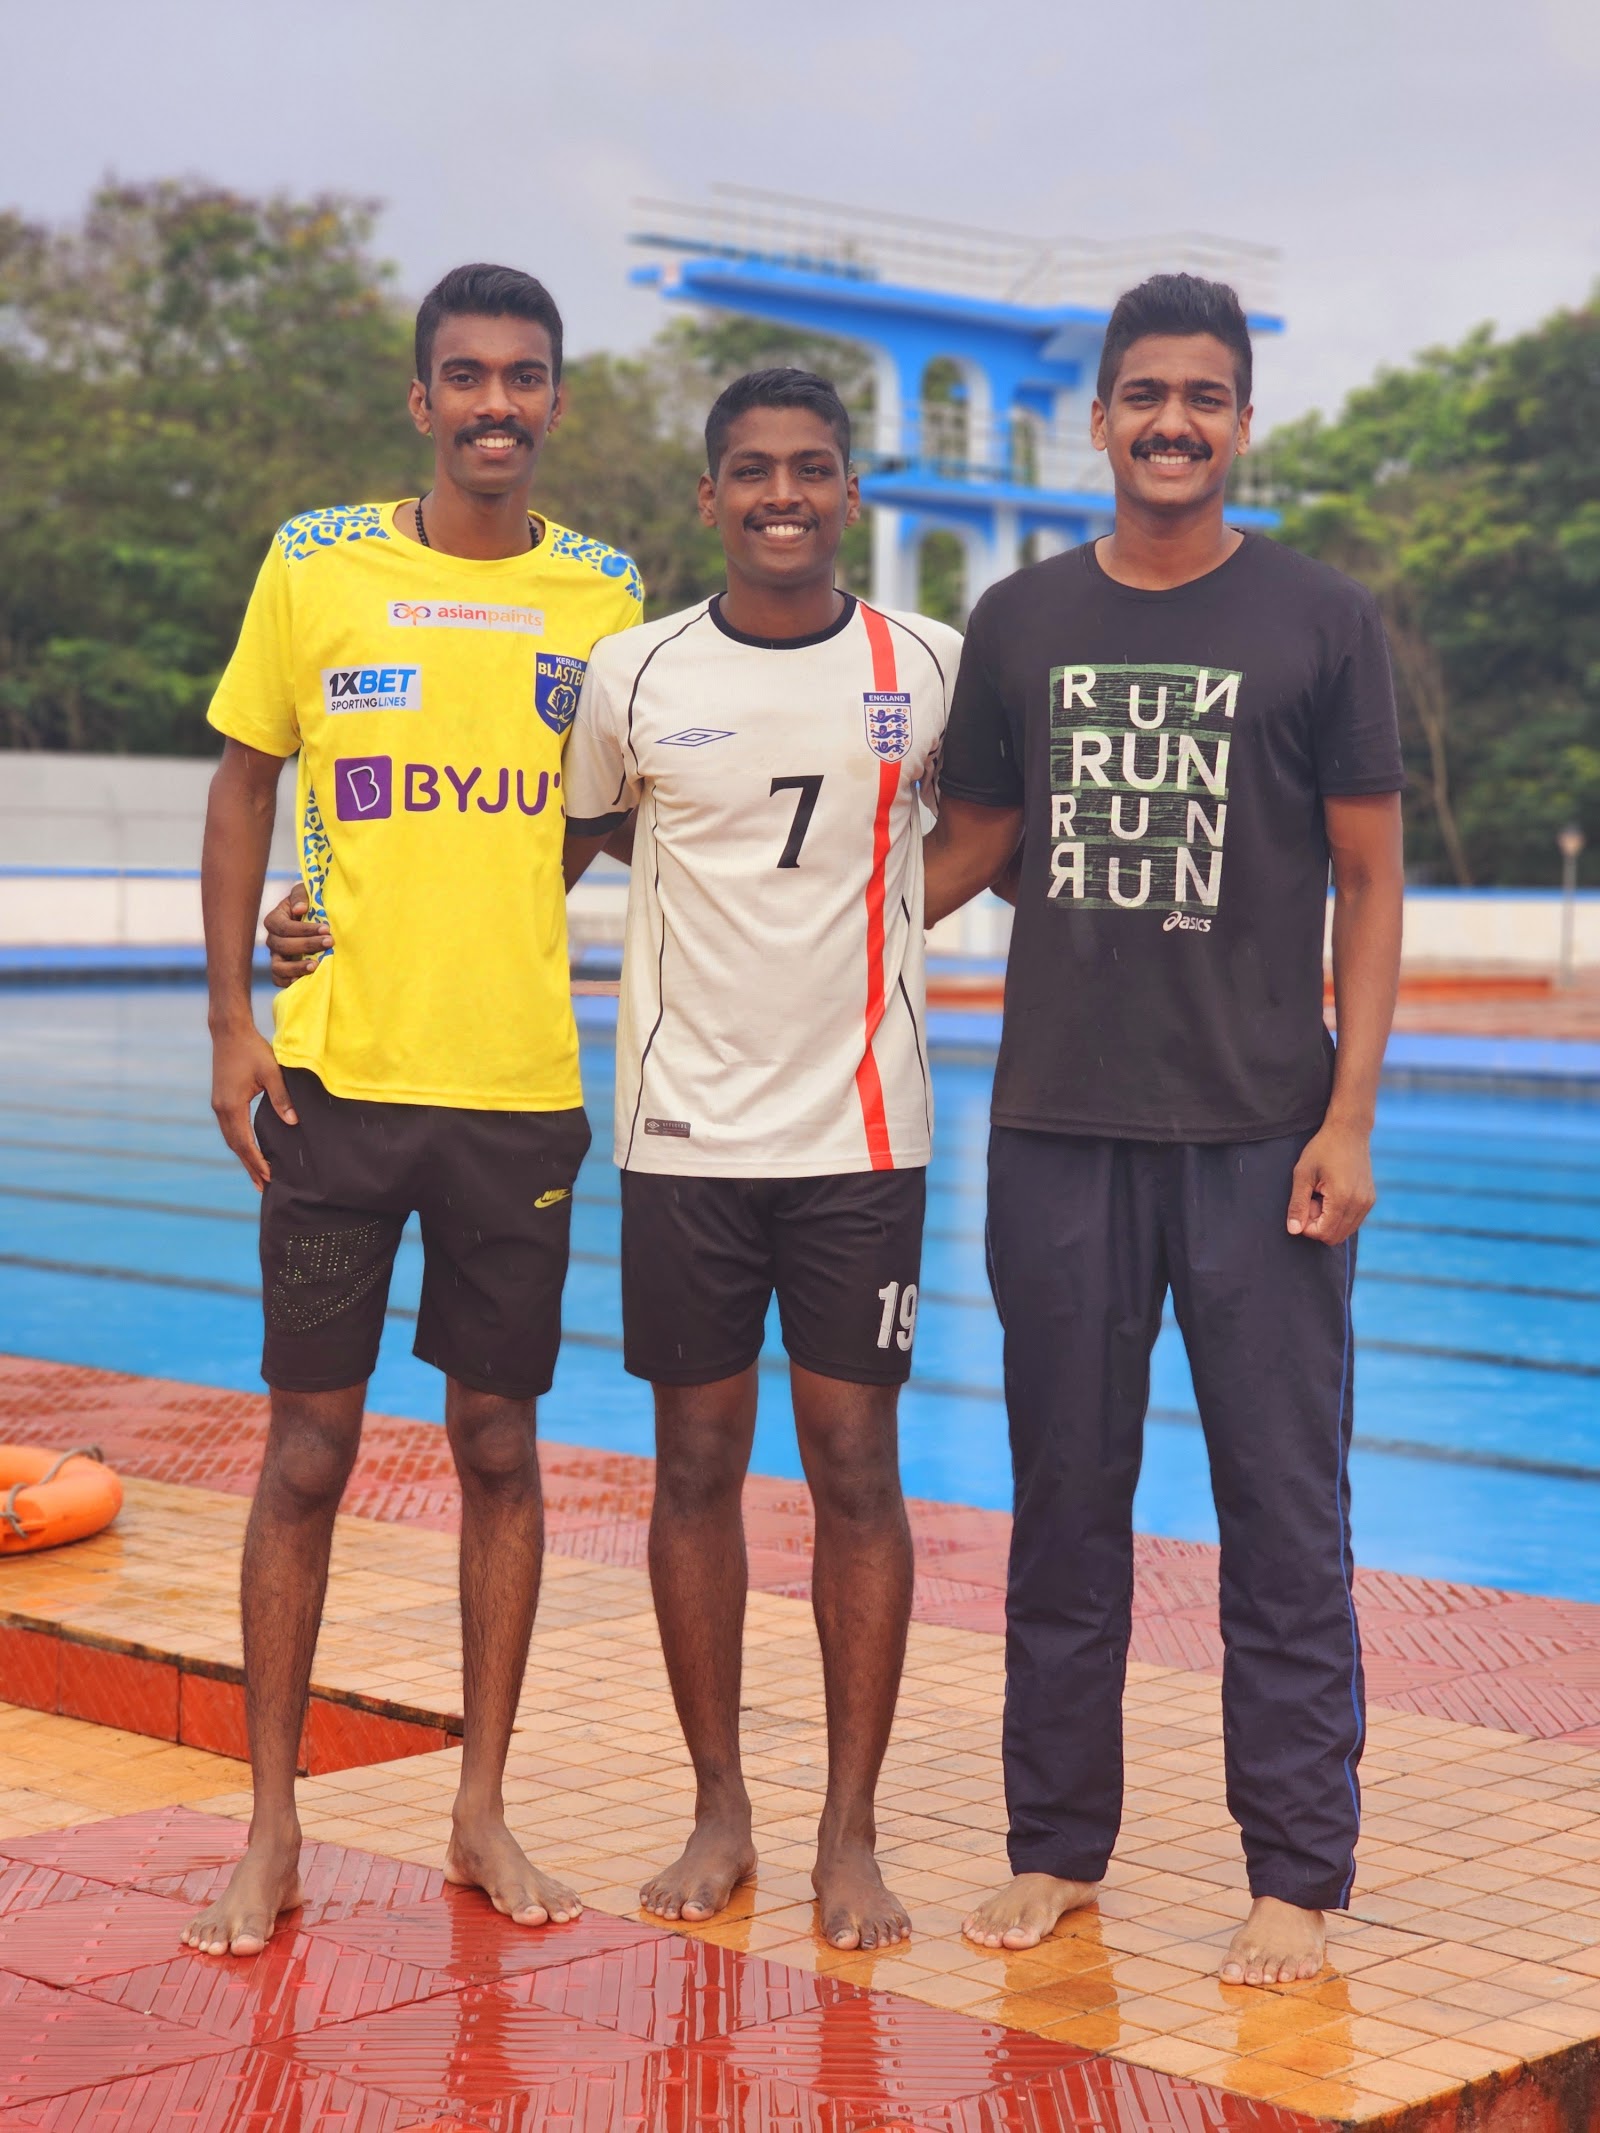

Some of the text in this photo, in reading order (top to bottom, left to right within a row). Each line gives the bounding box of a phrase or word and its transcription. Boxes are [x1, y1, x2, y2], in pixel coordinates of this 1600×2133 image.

[329, 669, 417, 697] 1XBET
[555, 656, 583, 670] KERALA
[868, 694, 906, 702] ENGLAND
[404, 763, 566, 818] BYJU'
[1072, 731, 1230, 796] RUN
[769, 774, 824, 869] 7
[1051, 794, 1227, 847] RUN
[877, 1281, 918, 1352] 19
